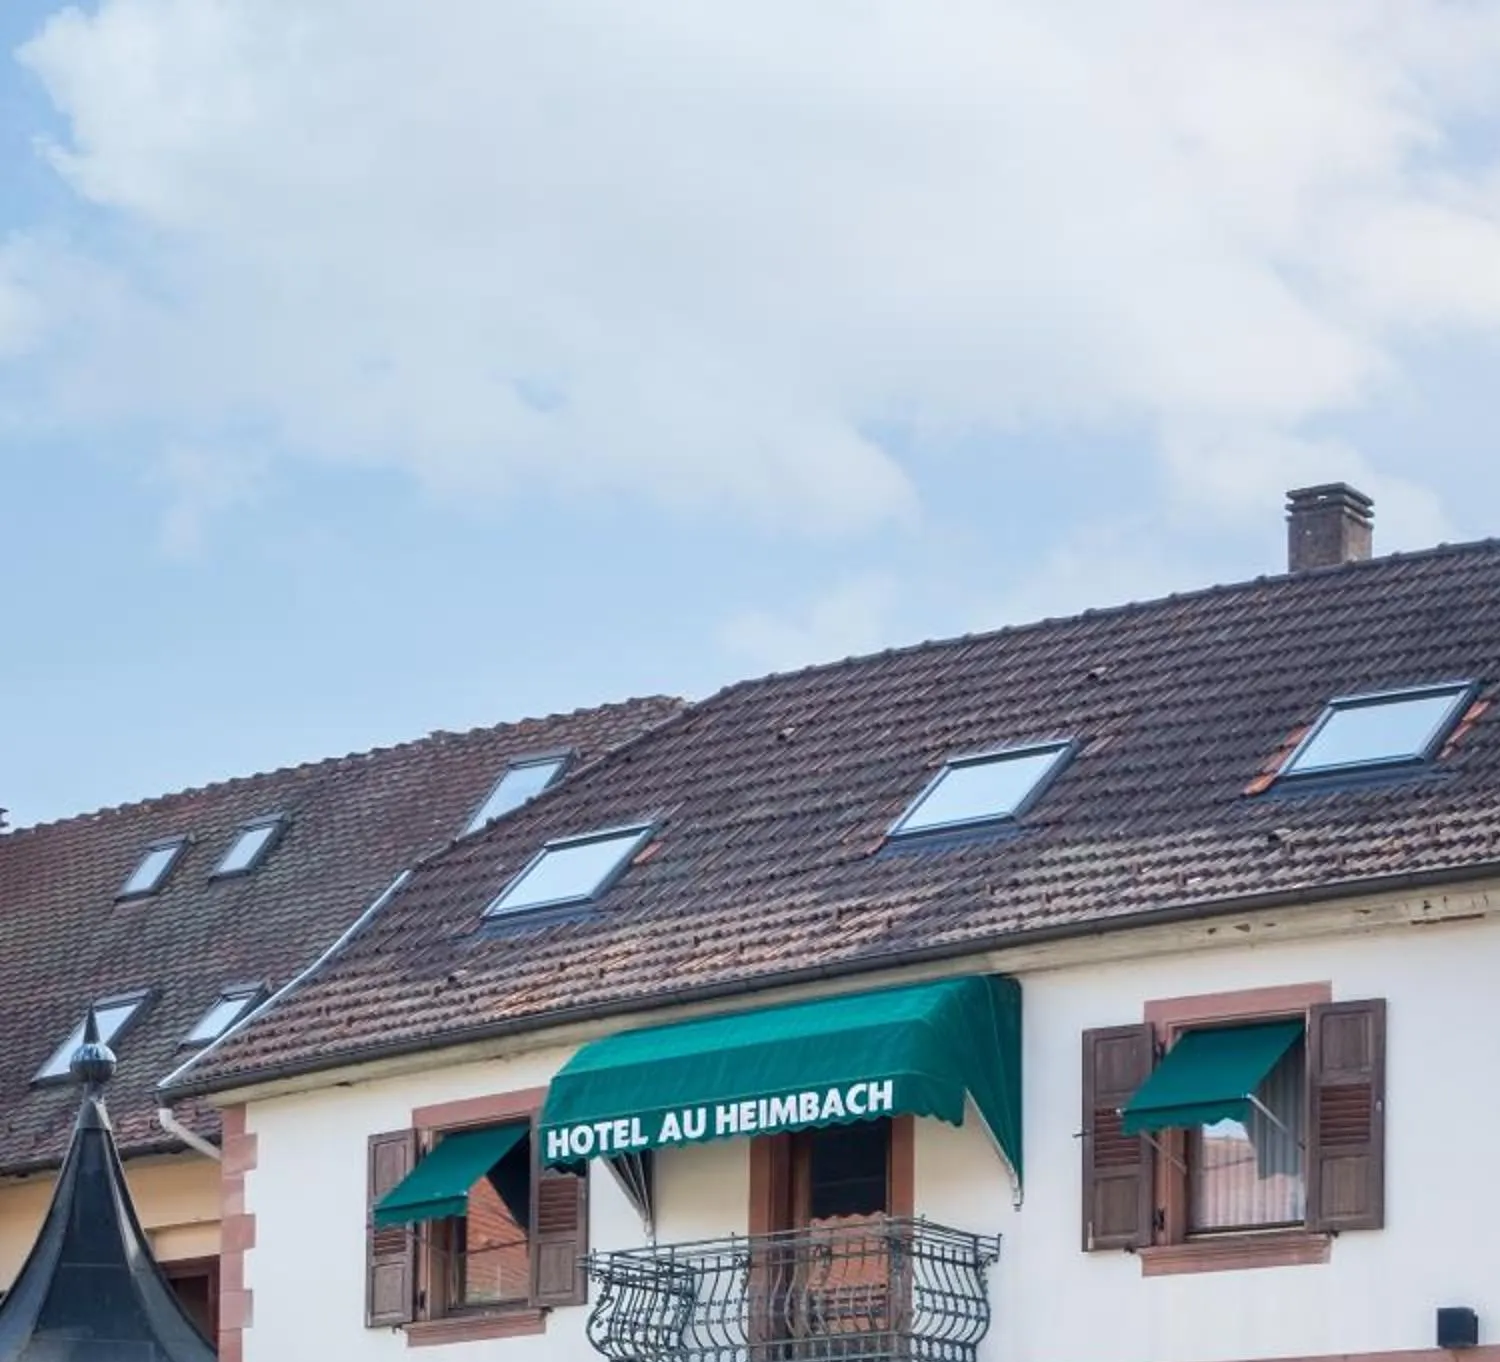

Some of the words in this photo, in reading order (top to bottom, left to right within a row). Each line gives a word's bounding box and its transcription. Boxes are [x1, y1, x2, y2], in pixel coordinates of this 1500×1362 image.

[547, 1117, 649, 1159] HOTEL
[658, 1107, 708, 1144] AU
[715, 1079, 894, 1136] HEIMBACH
